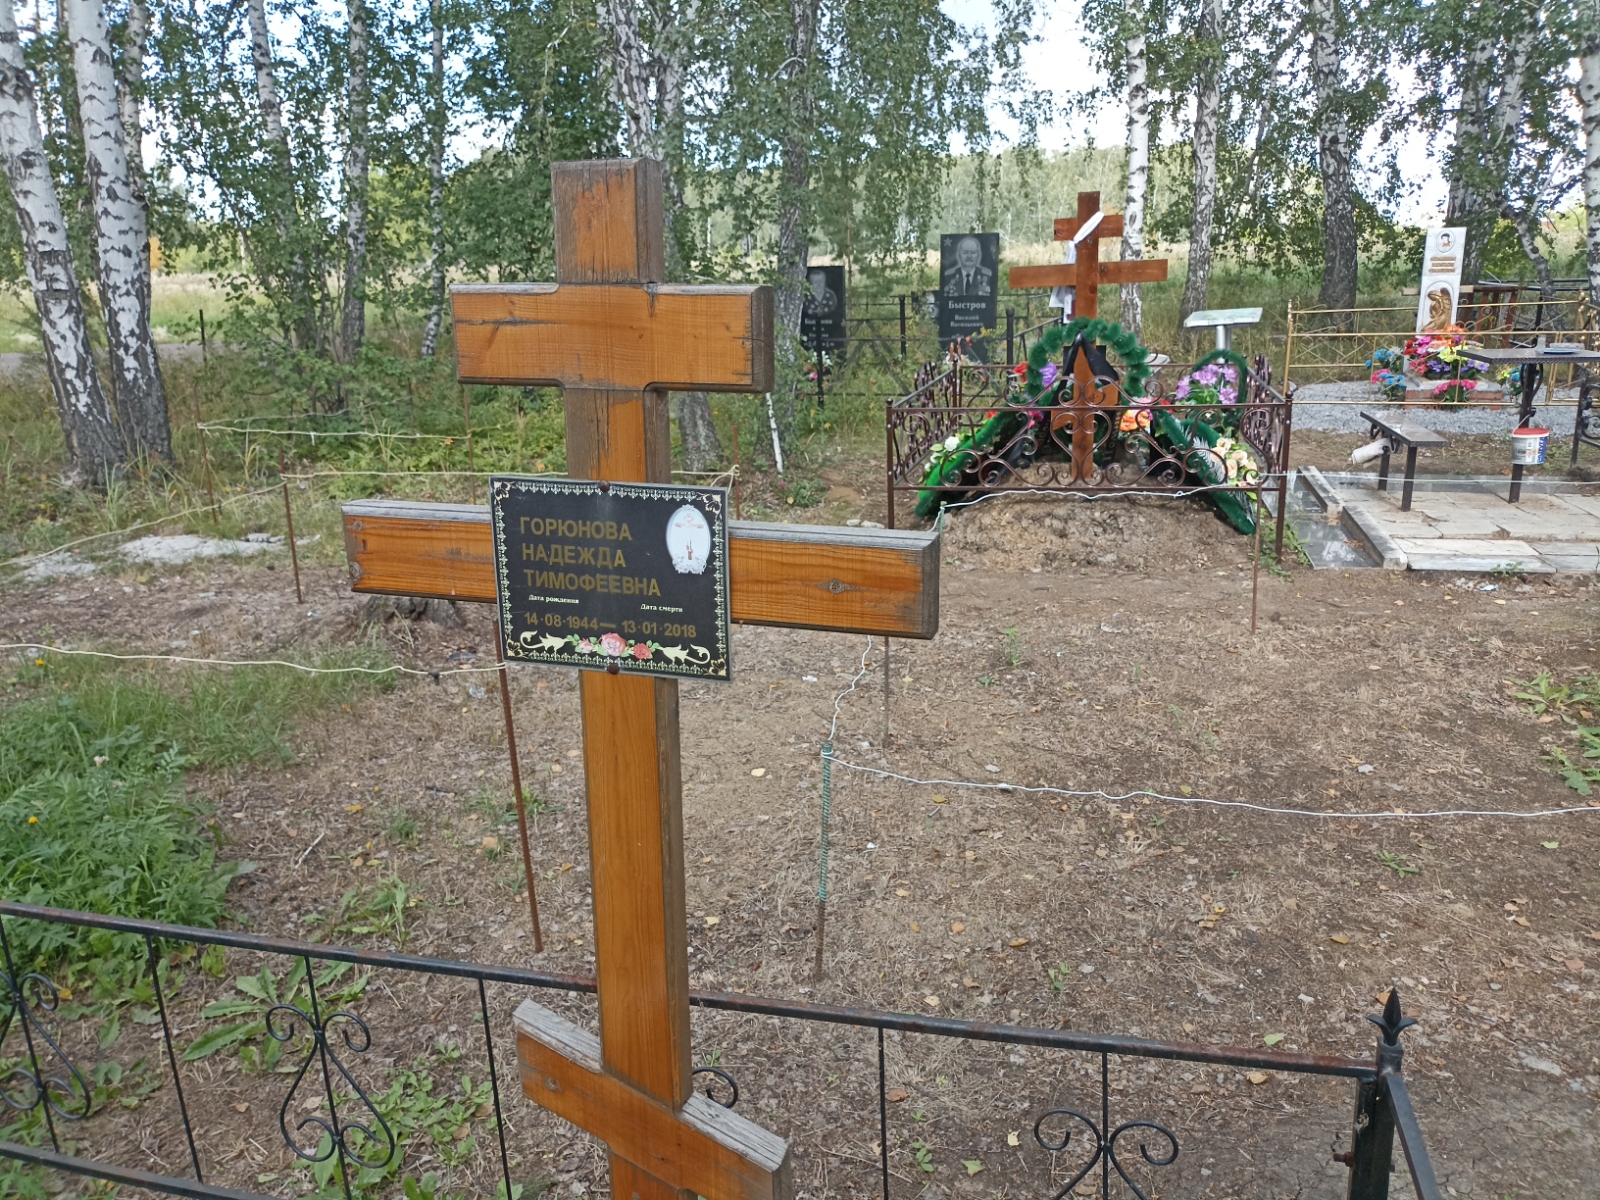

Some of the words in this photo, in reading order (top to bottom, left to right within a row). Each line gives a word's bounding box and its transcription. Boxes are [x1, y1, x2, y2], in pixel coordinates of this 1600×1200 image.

[948, 300, 986, 311] Быстров
[520, 516, 632, 541] ГОРЮНОВА
[521, 542, 626, 569] НАДЕЖДА
[523, 569, 661, 597] ТИМОФЕЕВНА
[545, 596, 580, 604] рождения
[640, 603, 657, 611] Дата
[658, 605, 683, 613] смерти
